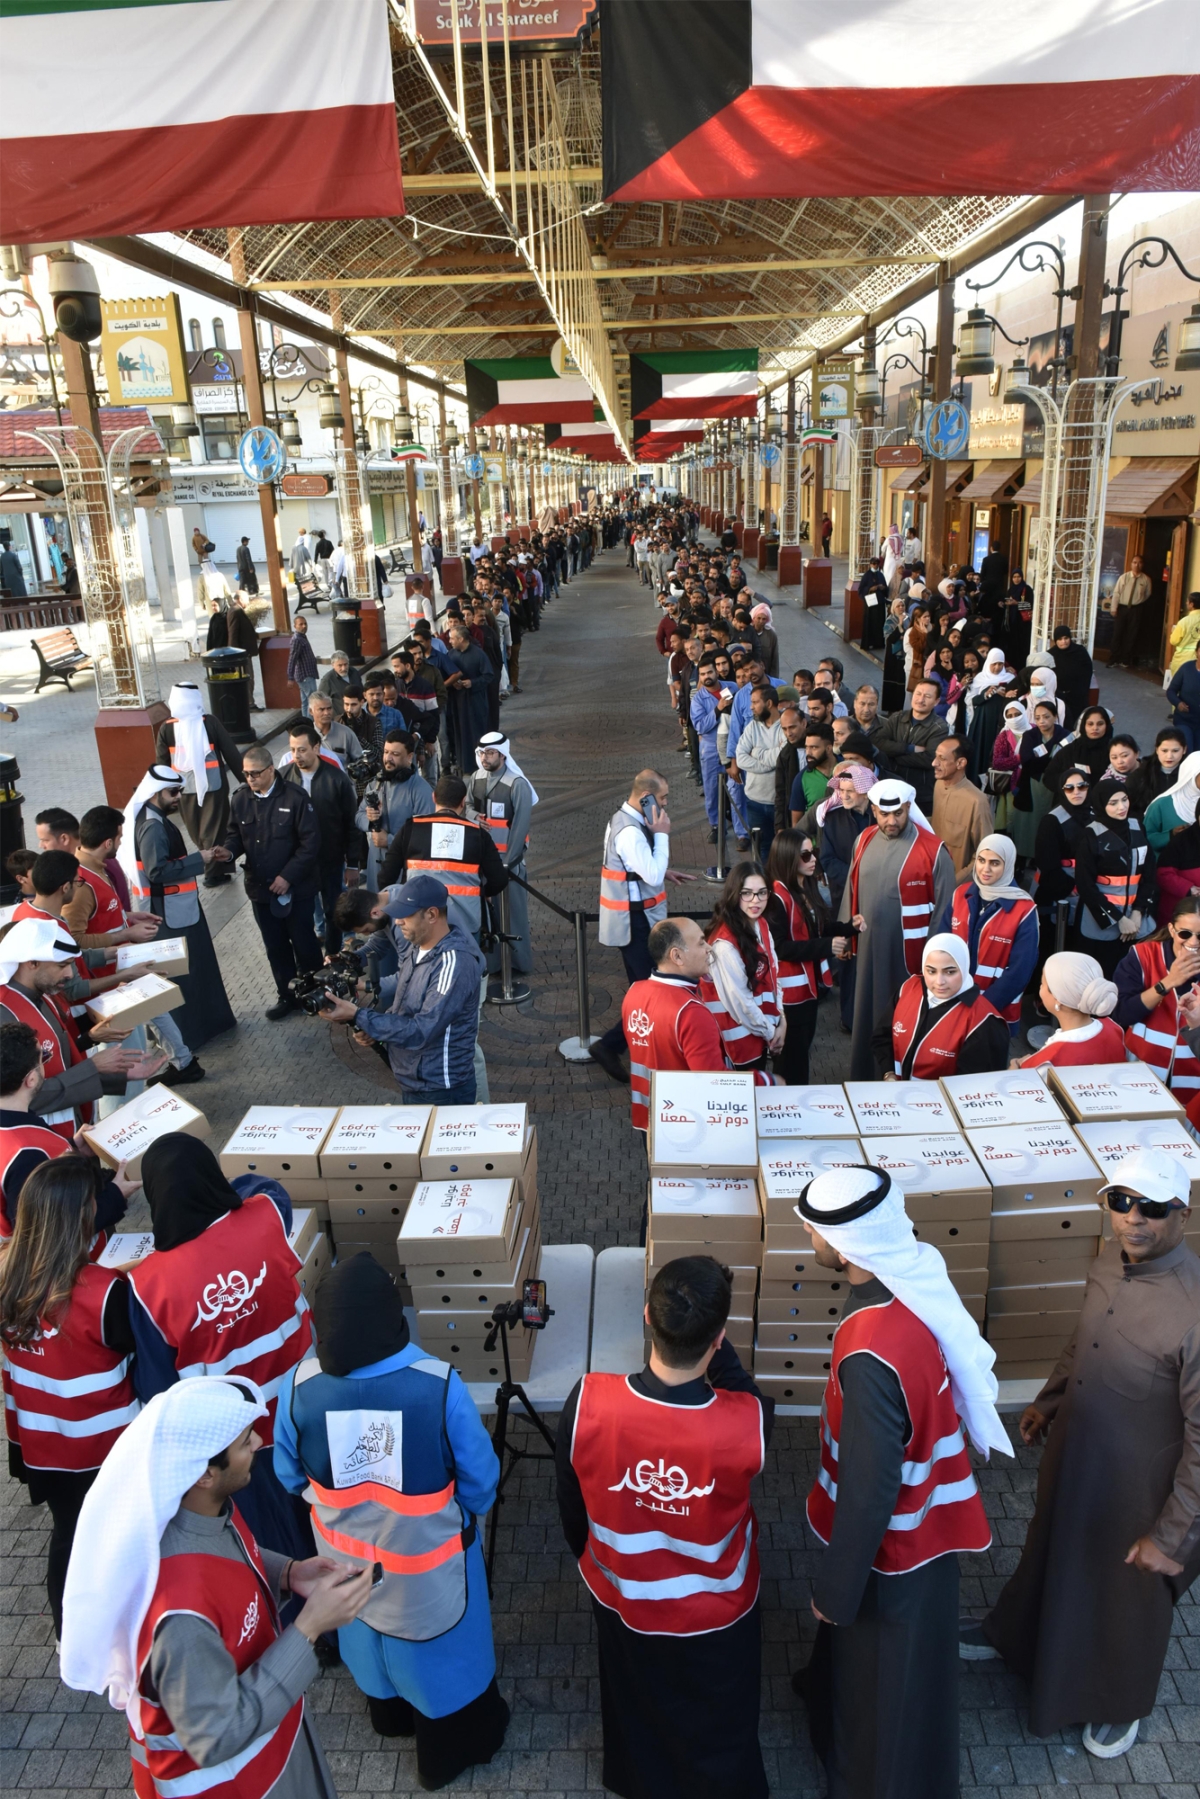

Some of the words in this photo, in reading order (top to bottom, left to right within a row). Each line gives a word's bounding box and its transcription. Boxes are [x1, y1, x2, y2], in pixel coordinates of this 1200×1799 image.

[436, 14, 473, 29] Souk
[496, 9, 559, 25] Sarareef
[114, 320, 141, 331] الكويت
[143, 320, 161, 329] بلدية
[194, 387, 222, 399] الصراف
[224, 387, 242, 398] مكز
[1160, 414, 1196, 430] PERFUMES
[707, 1100, 748, 1113] عوايدنا
[725, 1116, 749, 1128] دوم
[1027, 1139, 1073, 1148] عوايدنا
[922, 1149, 966, 1159] عوايدنا
[1053, 1147, 1078, 1156] دوم
[946, 1158, 970, 1166] دوم
[460, 1184, 472, 1197] دوم
[724, 1182, 749, 1191] دوم
[440, 1184, 458, 1207] عوايدنا
[215, 1301, 259, 1334] الخليج
[368, 1422, 385, 1432] البنك
[336, 1475, 356, 1486] Kuwait
[356, 1472, 371, 1481] Food
[371, 1471, 383, 1481] Bank
[607, 1458, 716, 1502] سواعد
[635, 1497, 690, 1516] الخليج
